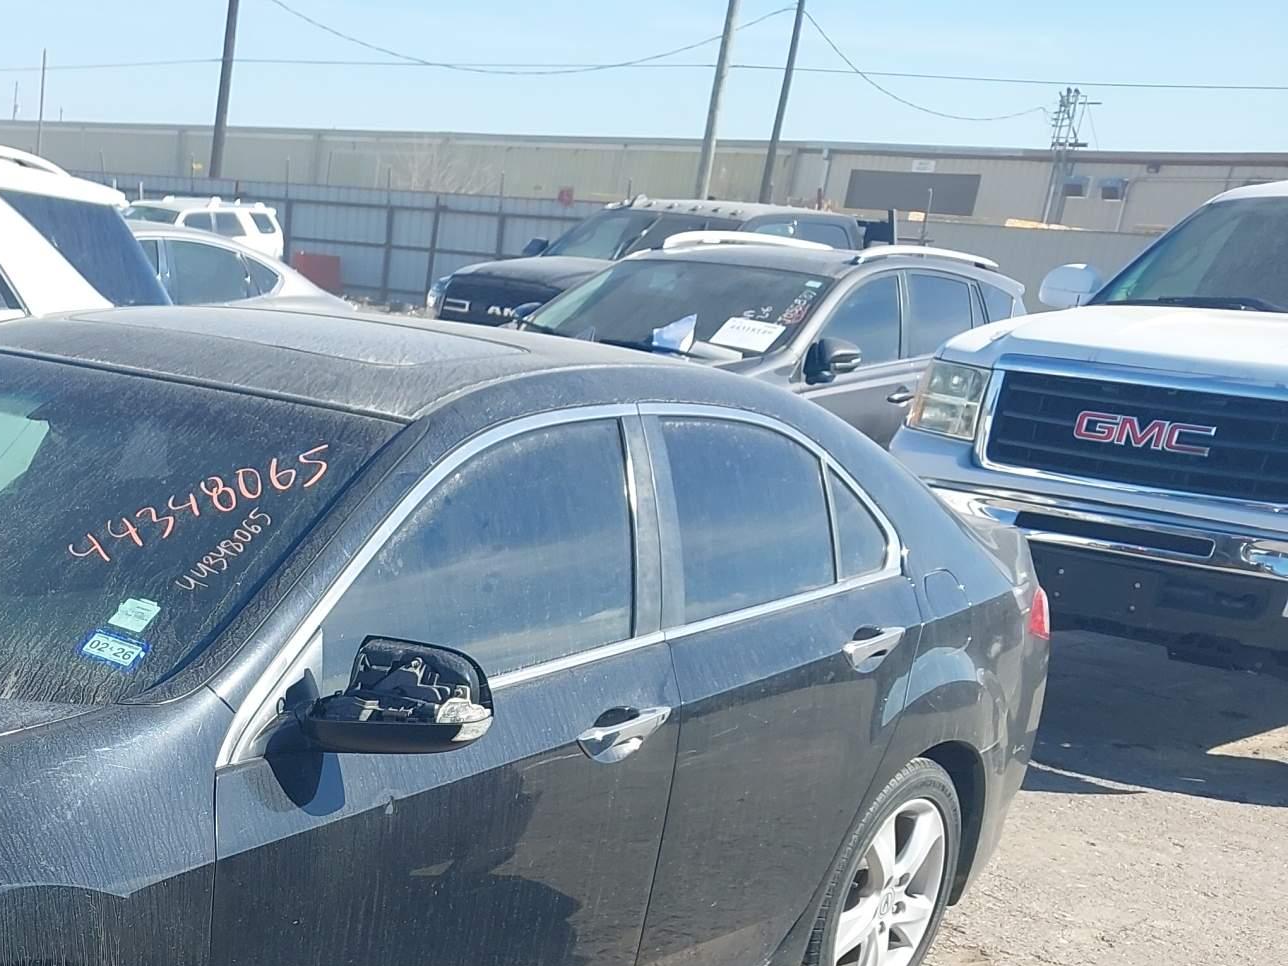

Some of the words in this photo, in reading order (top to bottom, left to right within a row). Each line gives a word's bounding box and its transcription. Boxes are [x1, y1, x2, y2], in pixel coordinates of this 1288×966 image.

[1073, 410, 1217, 457] GMC
[68, 444, 329, 562] 44348065
[175, 507, 272, 590] 44348065
